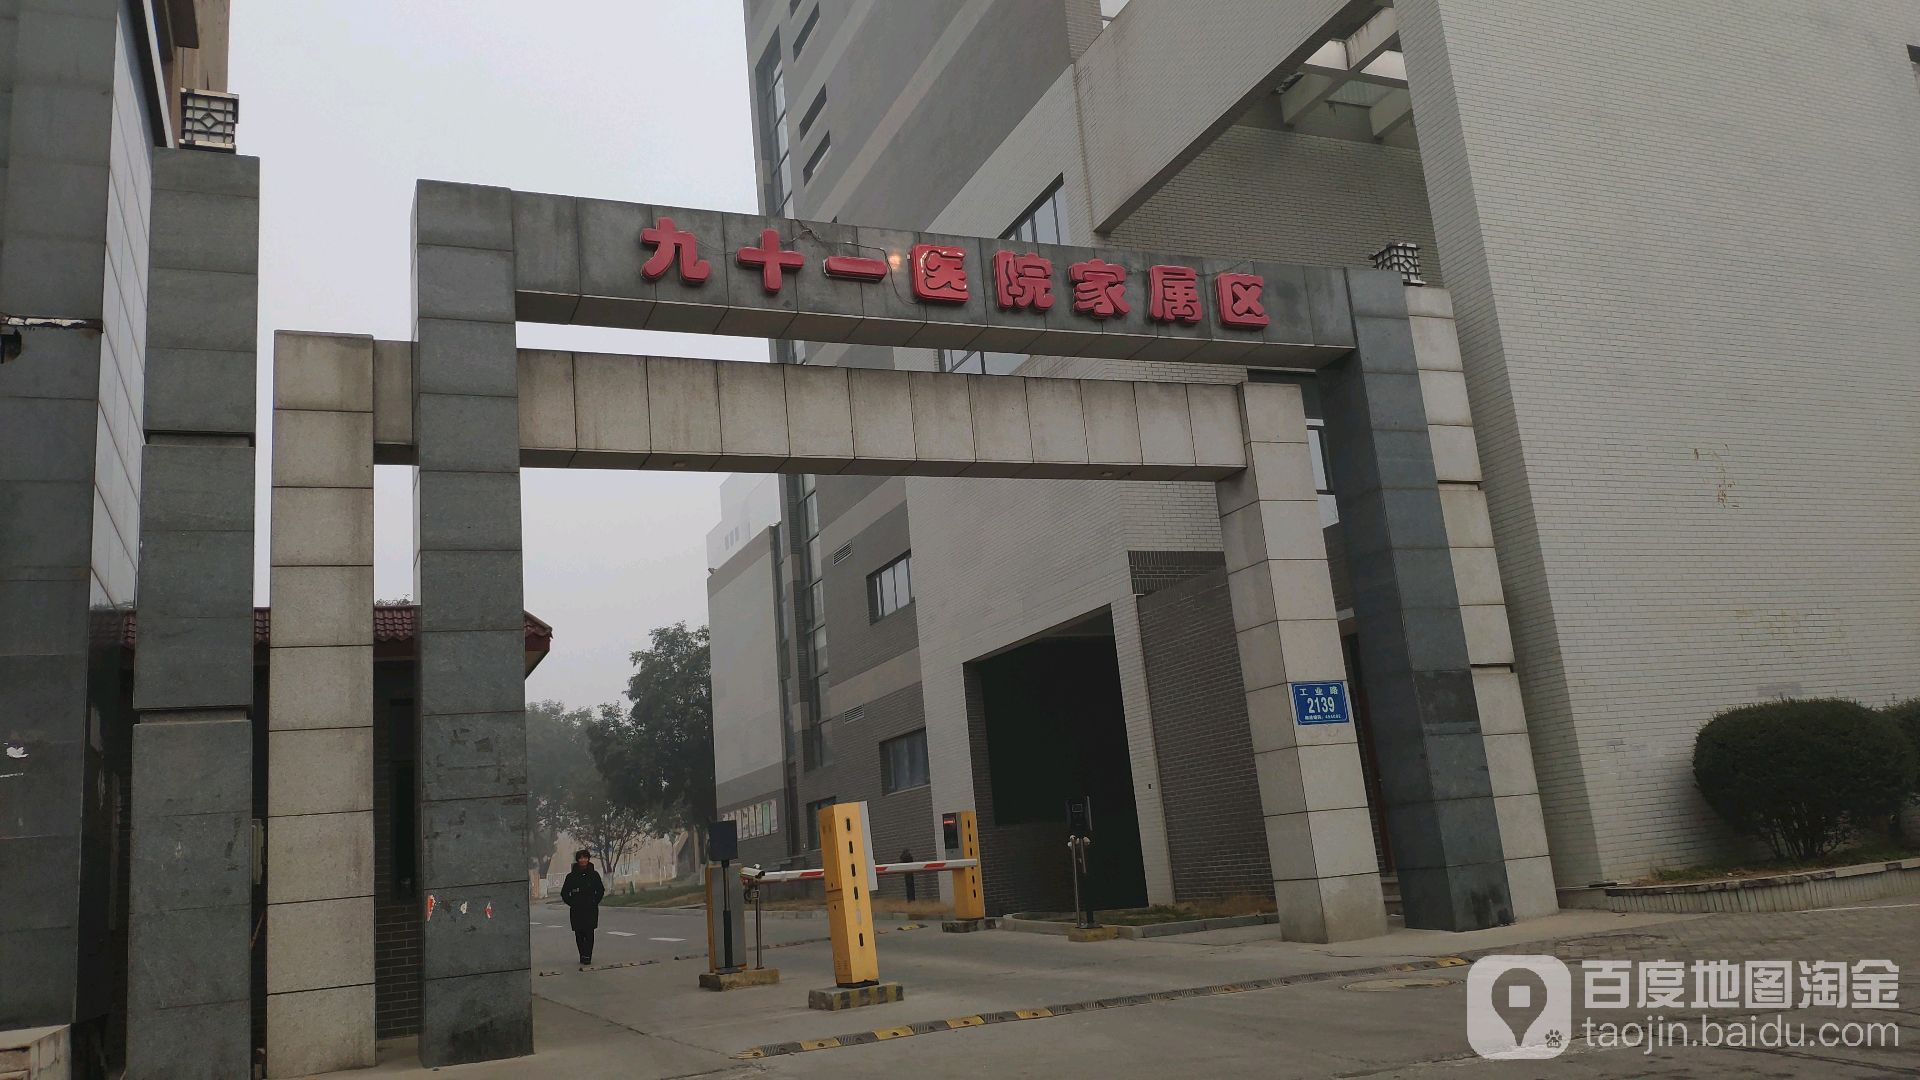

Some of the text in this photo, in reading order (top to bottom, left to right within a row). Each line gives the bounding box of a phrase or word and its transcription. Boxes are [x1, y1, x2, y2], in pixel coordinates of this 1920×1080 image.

[640, 216, 1270, 329] 九十一医院家属区
[1299, 686, 1338, 696] 工业路
[1307, 696, 1335, 714] 2139
